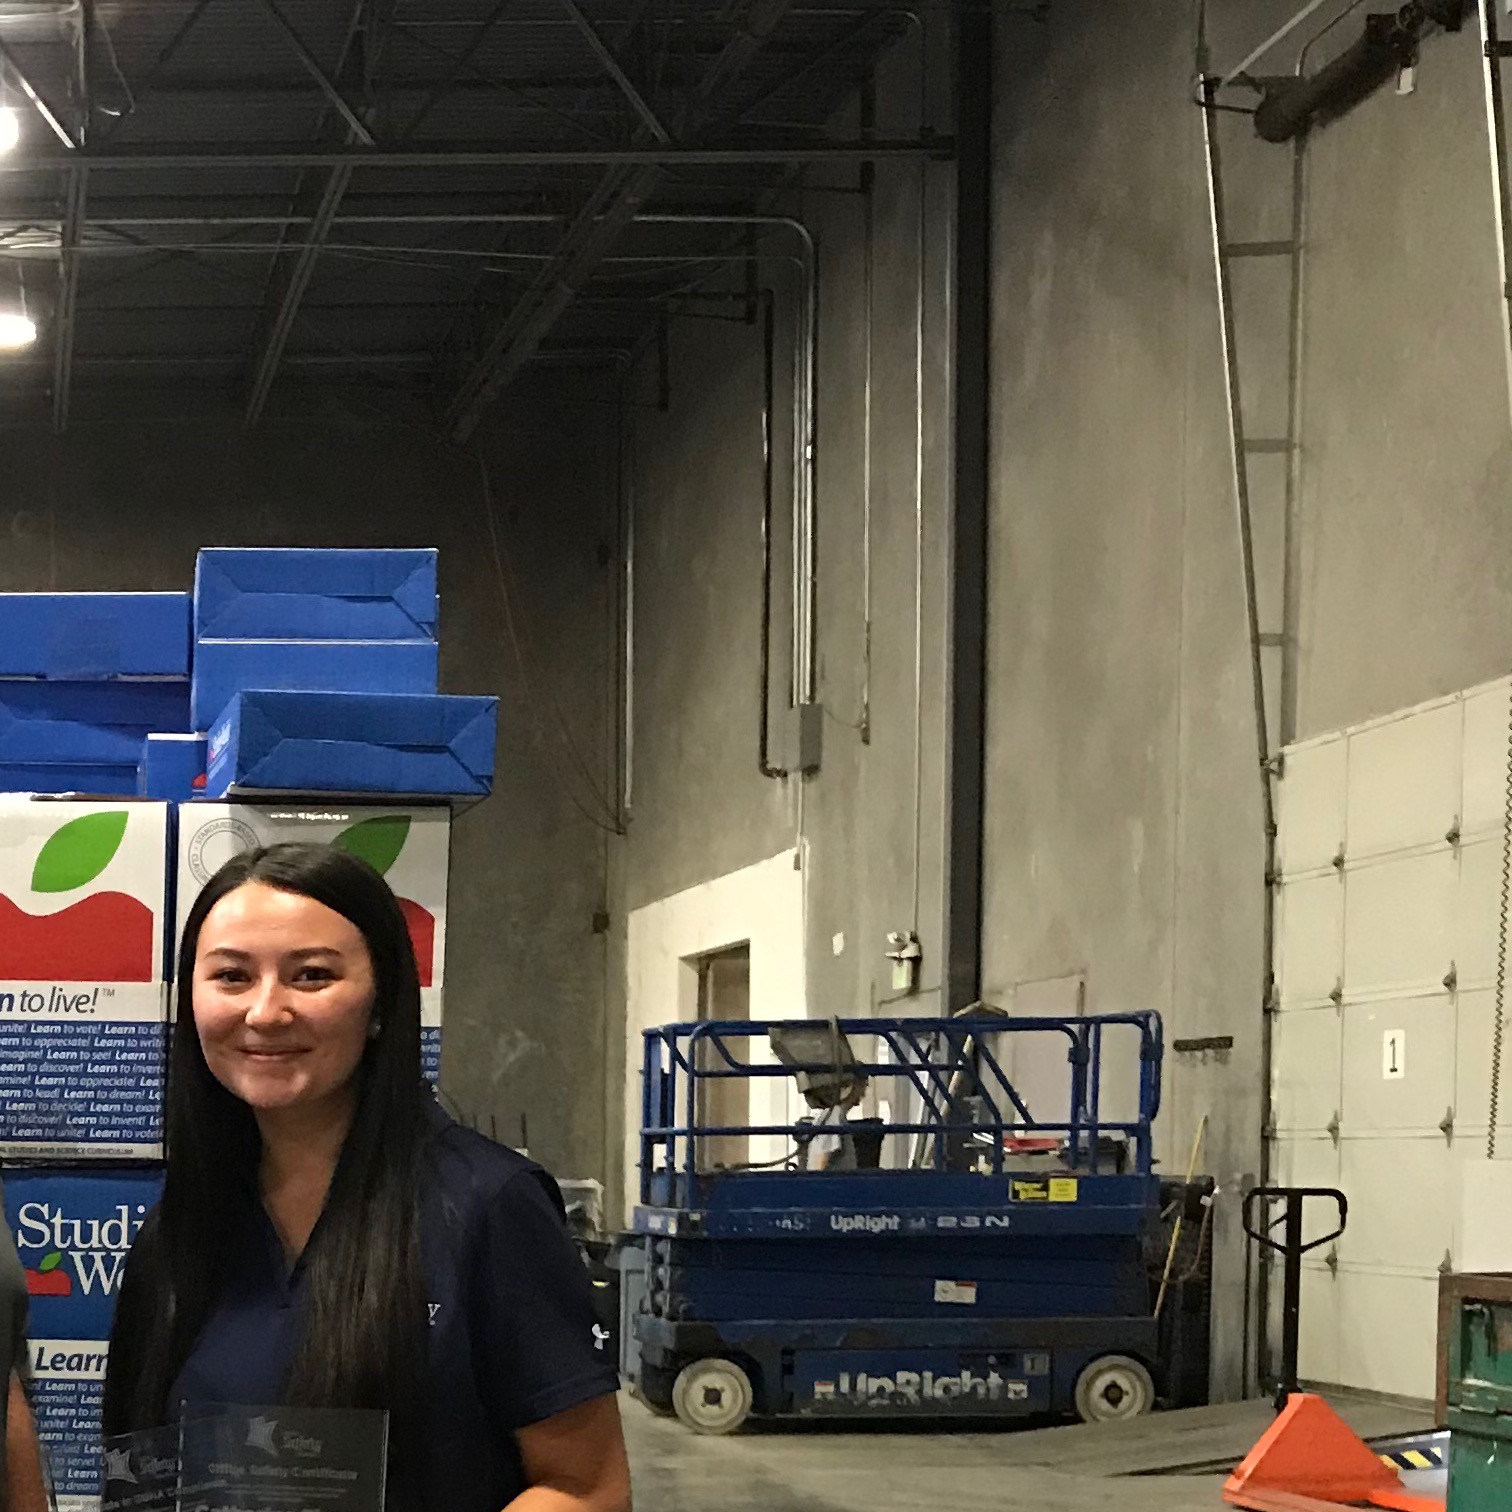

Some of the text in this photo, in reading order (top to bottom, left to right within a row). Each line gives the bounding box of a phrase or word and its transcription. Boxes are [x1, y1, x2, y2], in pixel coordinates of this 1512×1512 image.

[20, 990, 43, 1012] to
[48, 986, 99, 1013] live!
[31, 1023, 61, 1033] Learn
[64, 1025, 74, 1033] to
[104, 1024, 135, 1034] Learn
[138, 1025, 148, 1034] to
[22, 1037, 32, 1046] to
[94, 1037, 124, 1047] Learn
[127, 1038, 138, 1047] to
[47, 1049, 77, 1059] Learn
[80, 1051, 90, 1059] to
[115, 1050, 146, 1060] Learn
[1389, 1037, 1398, 1073] 1
[27, 1063, 37, 1071] to
[87, 1063, 117, 1073] Learn
[120, 1064, 130, 1073] to
[35, 1075, 65, 1085] Learn
[68, 1077, 78, 1085] to
[23, 1089, 33, 1098] to
[64, 1089, 95, 1098] Learn
[97, 1090, 107, 1099] to
[6, 1101, 36, 1110] Learn
[39, 1102, 48, 1111] to
[90, 1102, 120, 1111] Learn
[123, 1104, 133, 1112] to
[7, 1115, 16, 1123] to
[66, 1115, 97, 1124] Learn
[99, 1116, 109, 1124] to
[12, 1126, 42, 1136] Learn
[45, 1128, 55, 1136] to
[90, 1128, 120, 1138] Learn
[123, 1130, 133, 1138] to
[831, 1214, 900, 1233] UpRight
[46, 1382, 87, 1391] Learn to
[839, 1370, 1003, 1407] UpRight
[46, 1407, 88, 1416] Learn to
[68, 1469, 98, 1478] Learn
[55, 1482, 64, 1490] to
